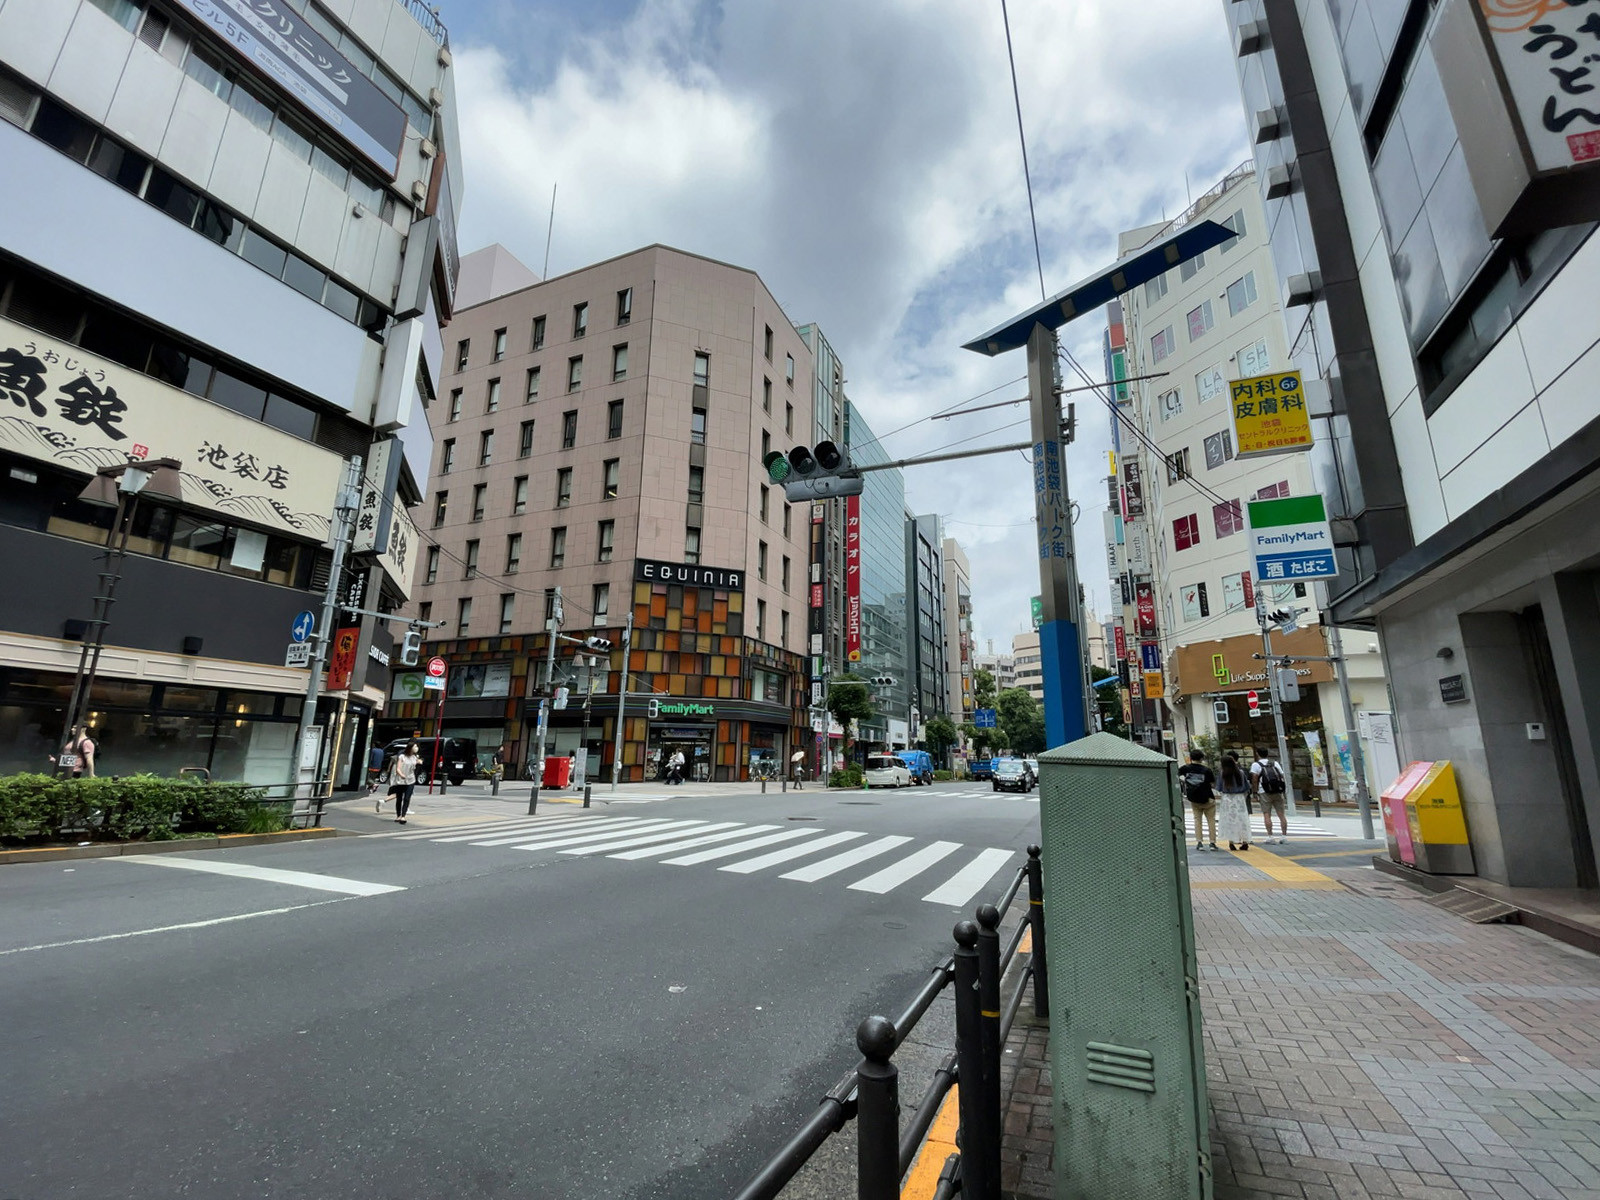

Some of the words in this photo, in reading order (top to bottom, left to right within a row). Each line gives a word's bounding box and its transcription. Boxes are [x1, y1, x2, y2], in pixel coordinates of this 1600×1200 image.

[244, 0, 351, 84] クリニック
[25, 342, 106, 382] うおじょう
[1233, 378, 1277, 401] 内科
[1236, 393, 1304, 419] 皮膚科
[197, 441, 290, 490] 池袋店
[848, 516, 859, 575] カラオケ
[1257, 530, 1325, 545] FamilyMart
[644, 564, 739, 586] EQUINIA
[1266, 561, 1285, 577] 酒
[1290, 560, 1328, 575] たばこ
